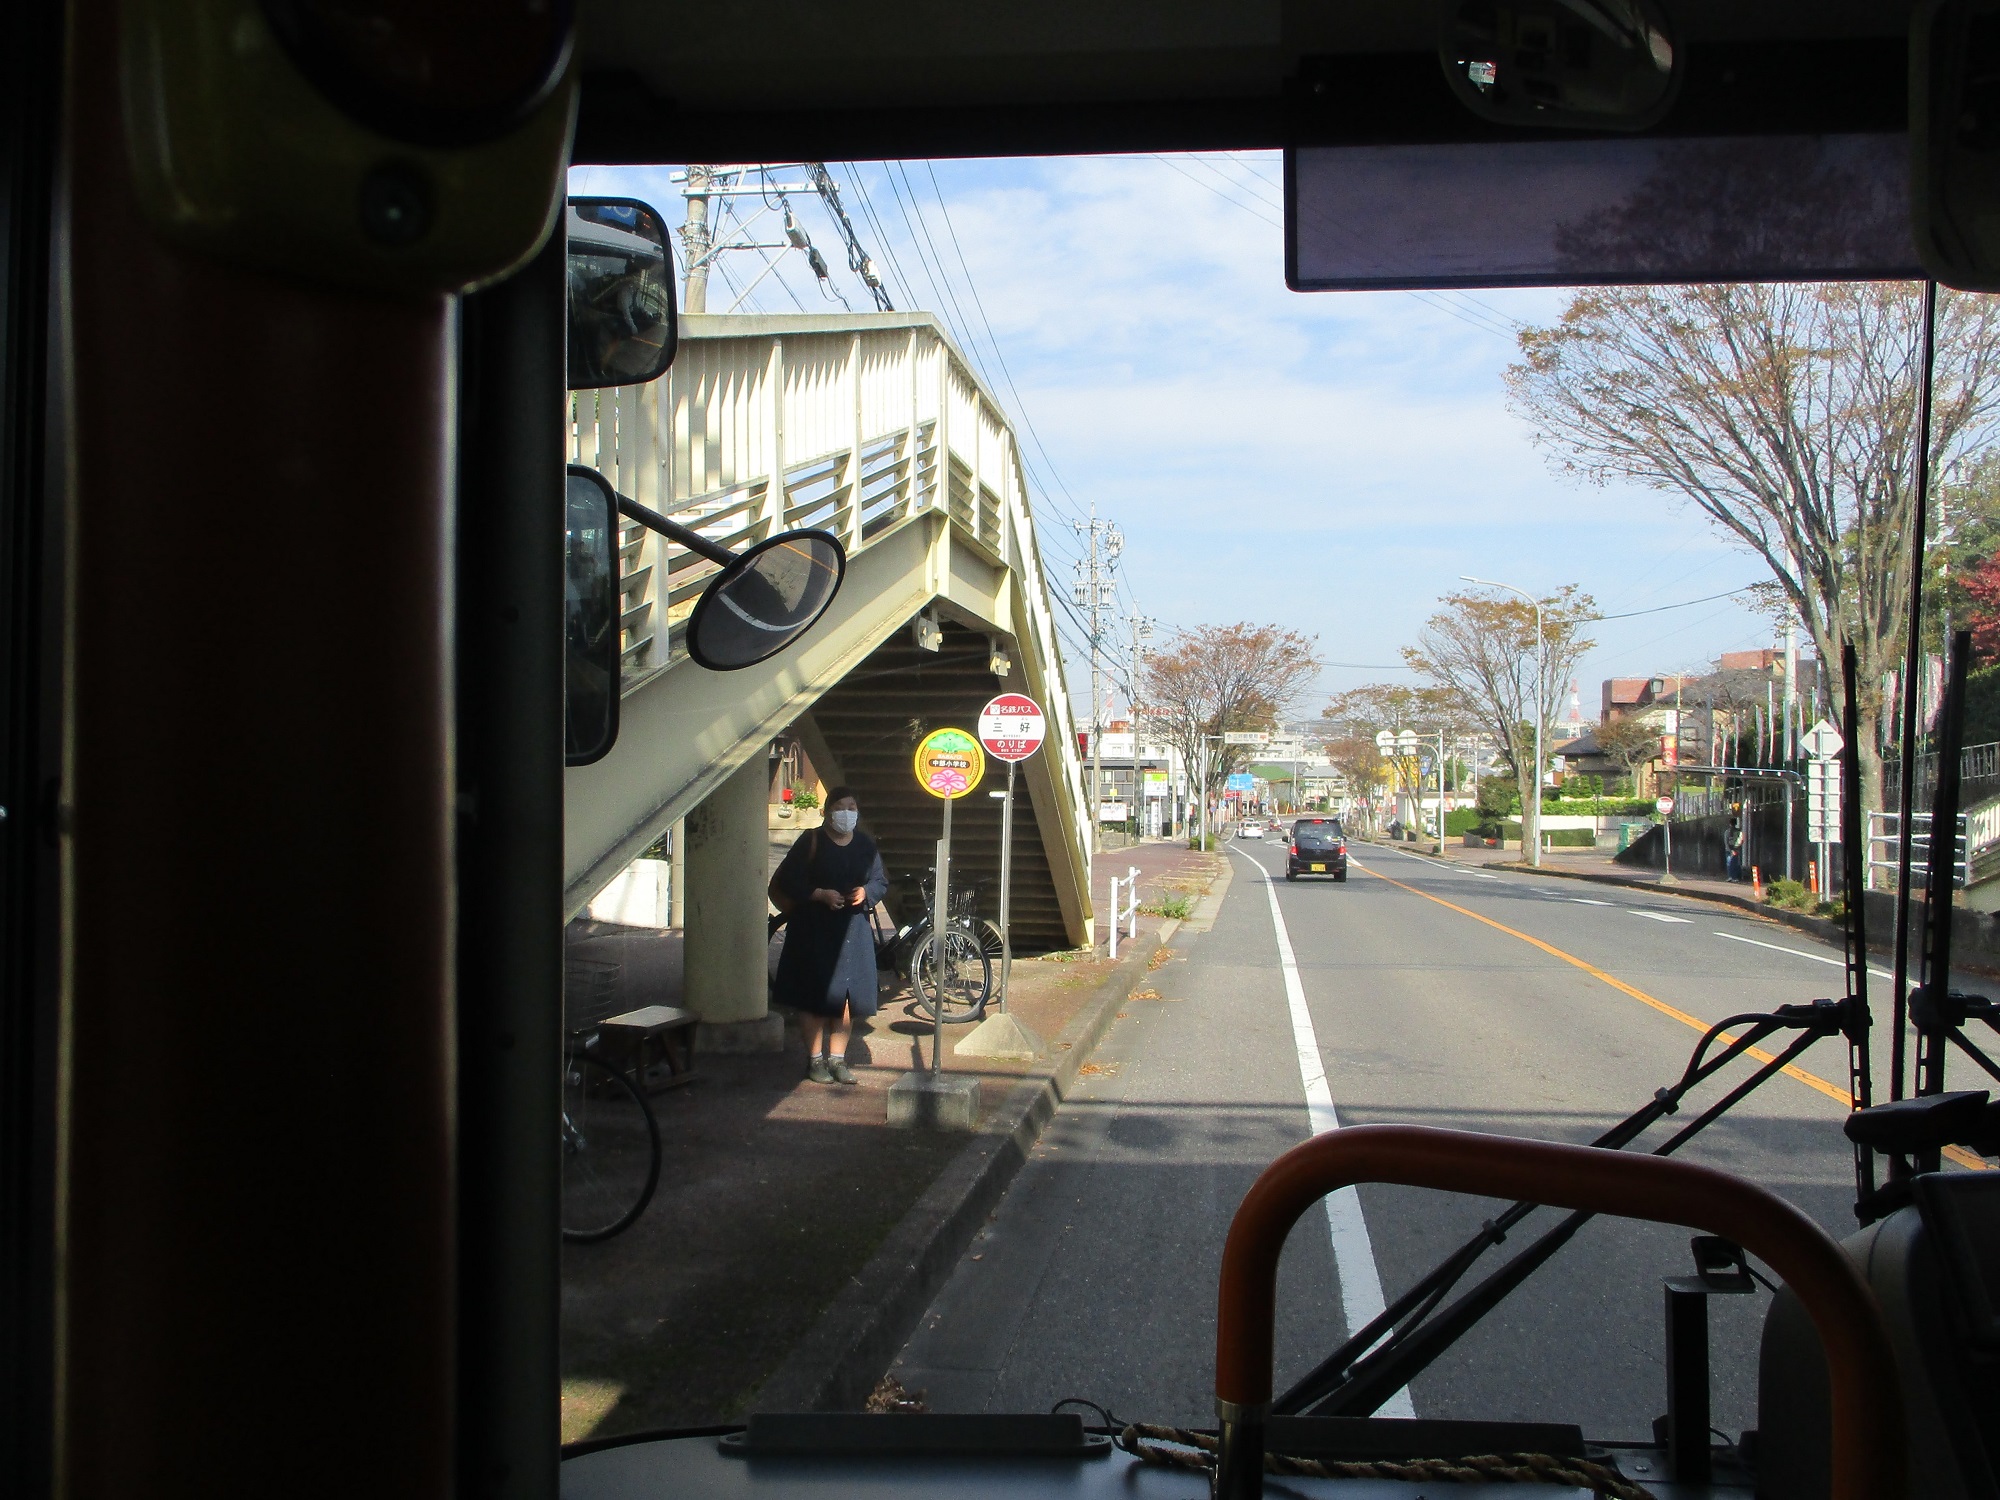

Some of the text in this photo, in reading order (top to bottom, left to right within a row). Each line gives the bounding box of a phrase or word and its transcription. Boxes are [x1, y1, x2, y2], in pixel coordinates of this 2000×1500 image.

[1000, 705, 1032, 713] 名鉄バス
[997, 740, 1026, 748] のりば
